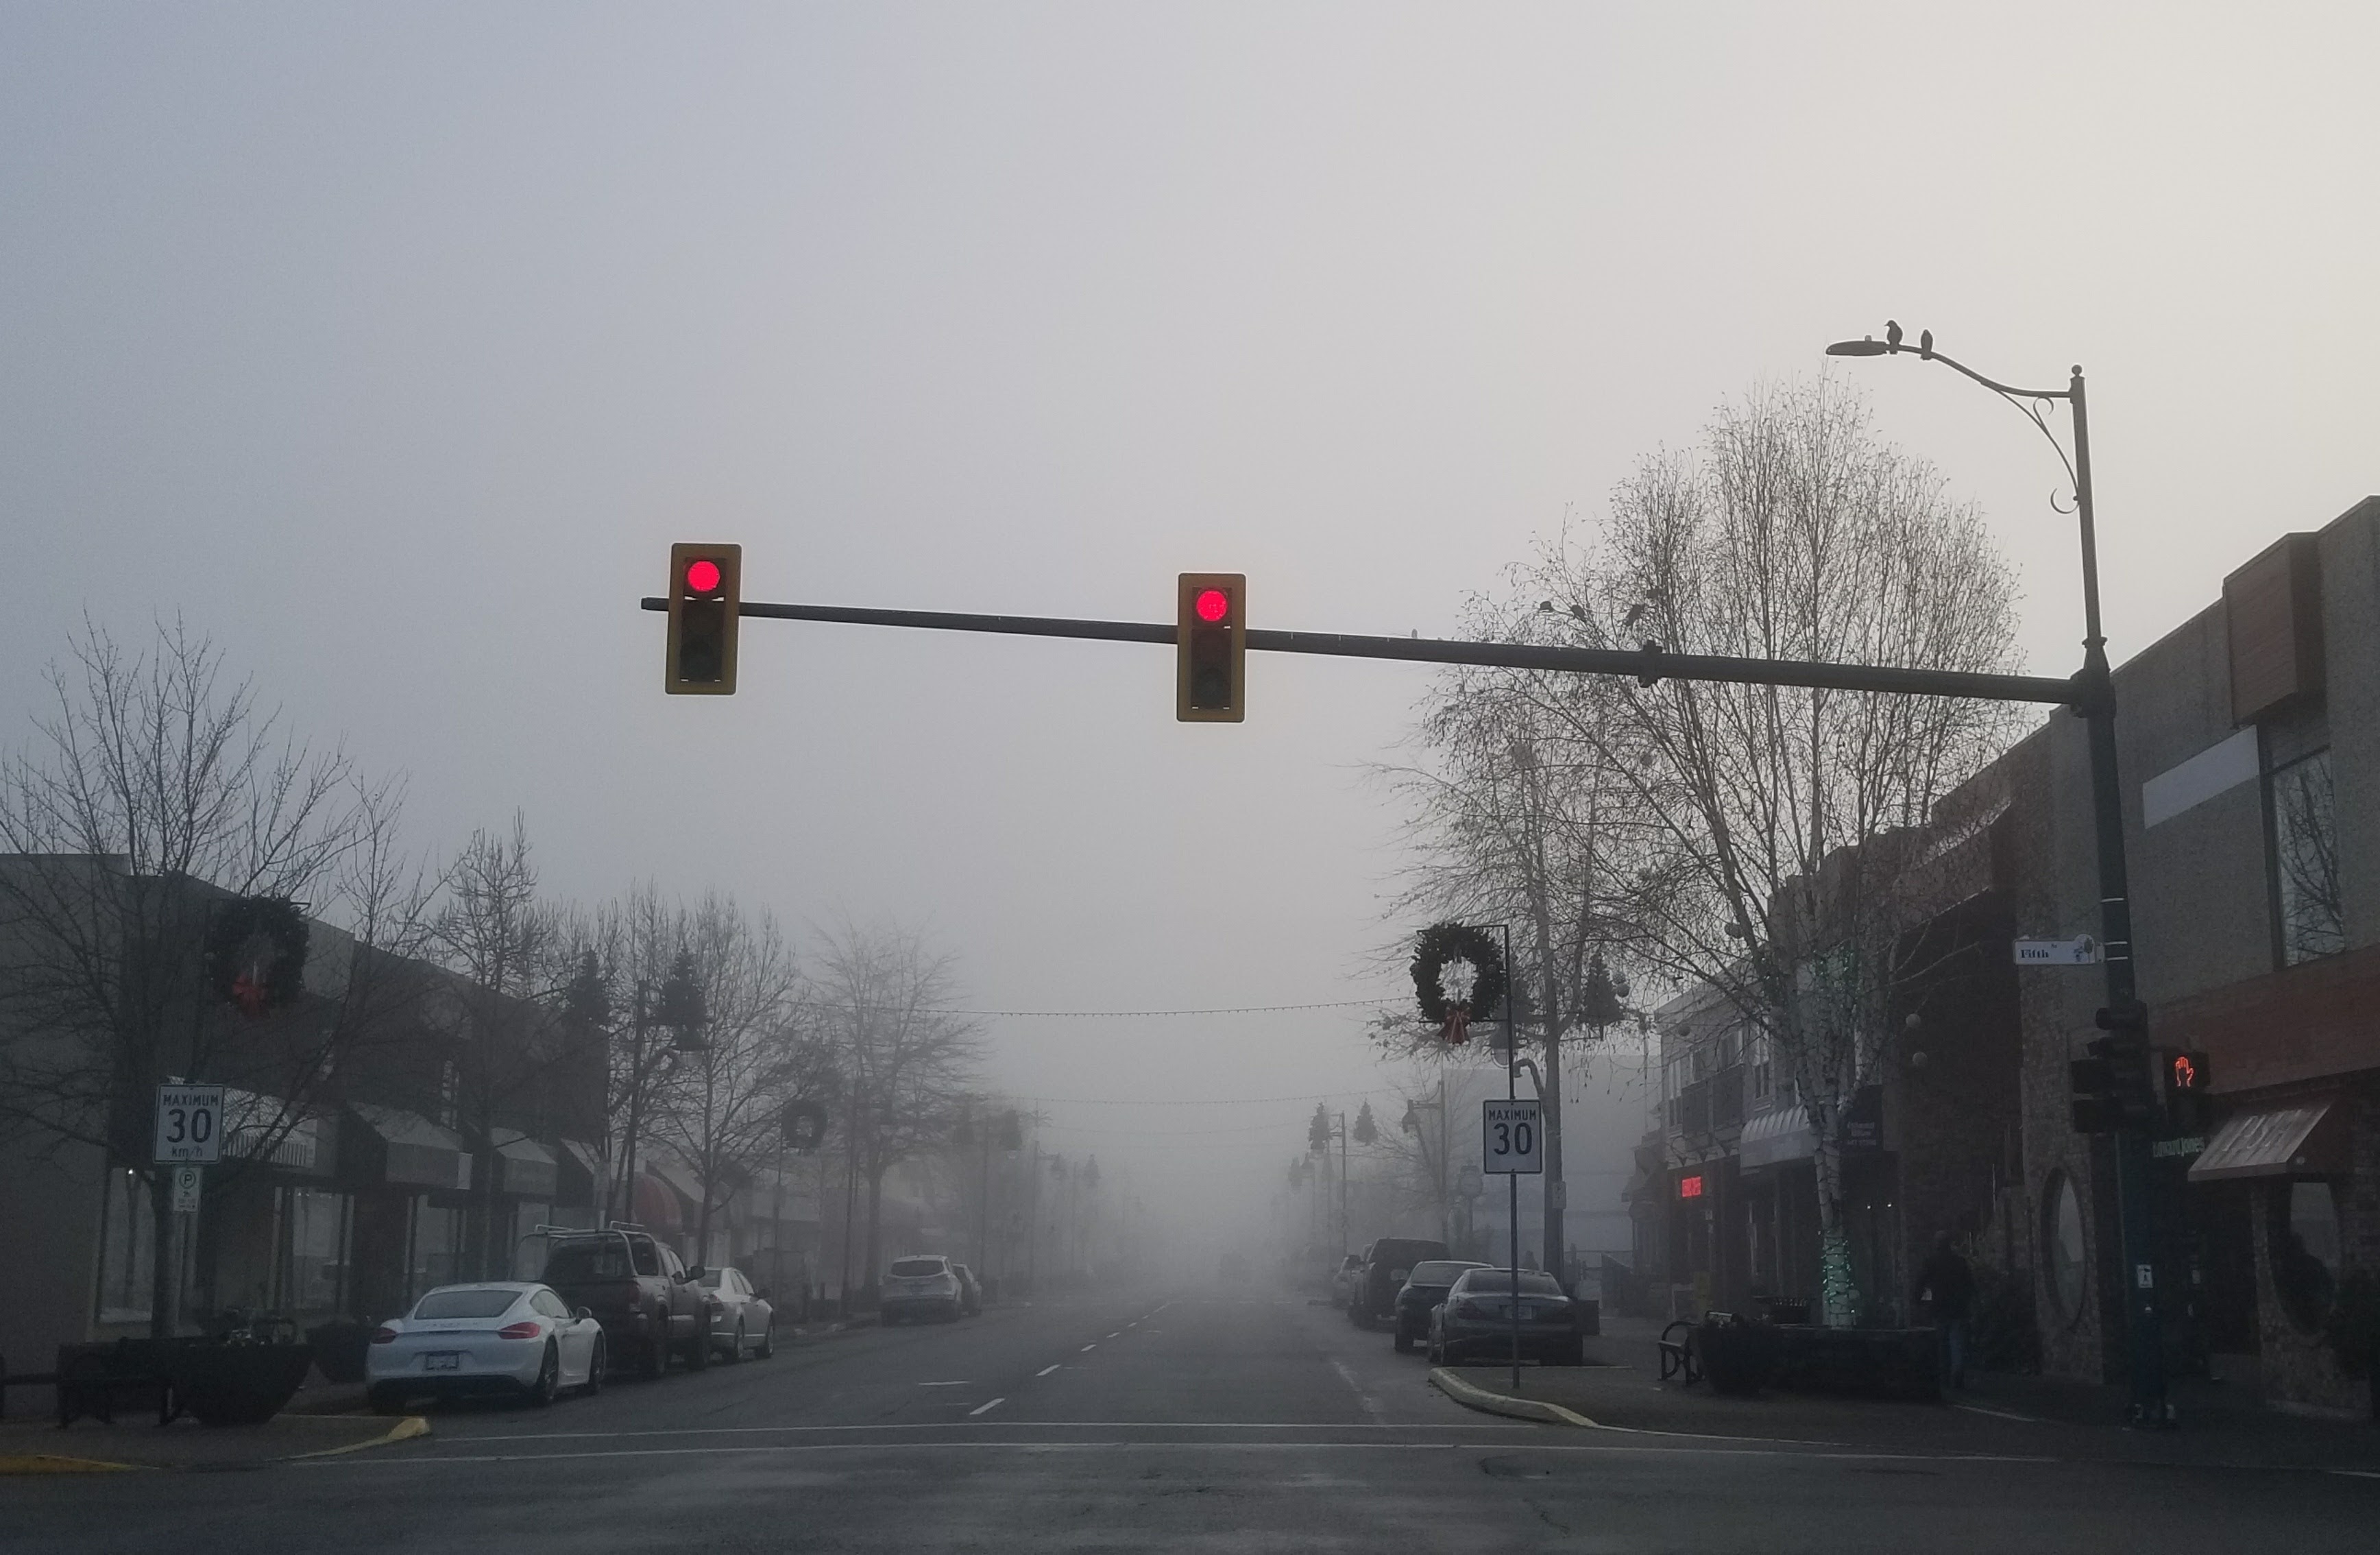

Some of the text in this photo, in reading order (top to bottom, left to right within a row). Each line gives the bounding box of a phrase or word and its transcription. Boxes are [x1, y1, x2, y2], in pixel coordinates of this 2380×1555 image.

[2021, 950, 2048, 958] Fifth
[164, 1094, 219, 1106] MAXIMUM
[1489, 1109, 1536, 1120] MAXIMUM
[167, 1109, 211, 1143] 30
[1494, 1122, 1532, 1155] 30
[172, 1146, 203, 1157] km/h
